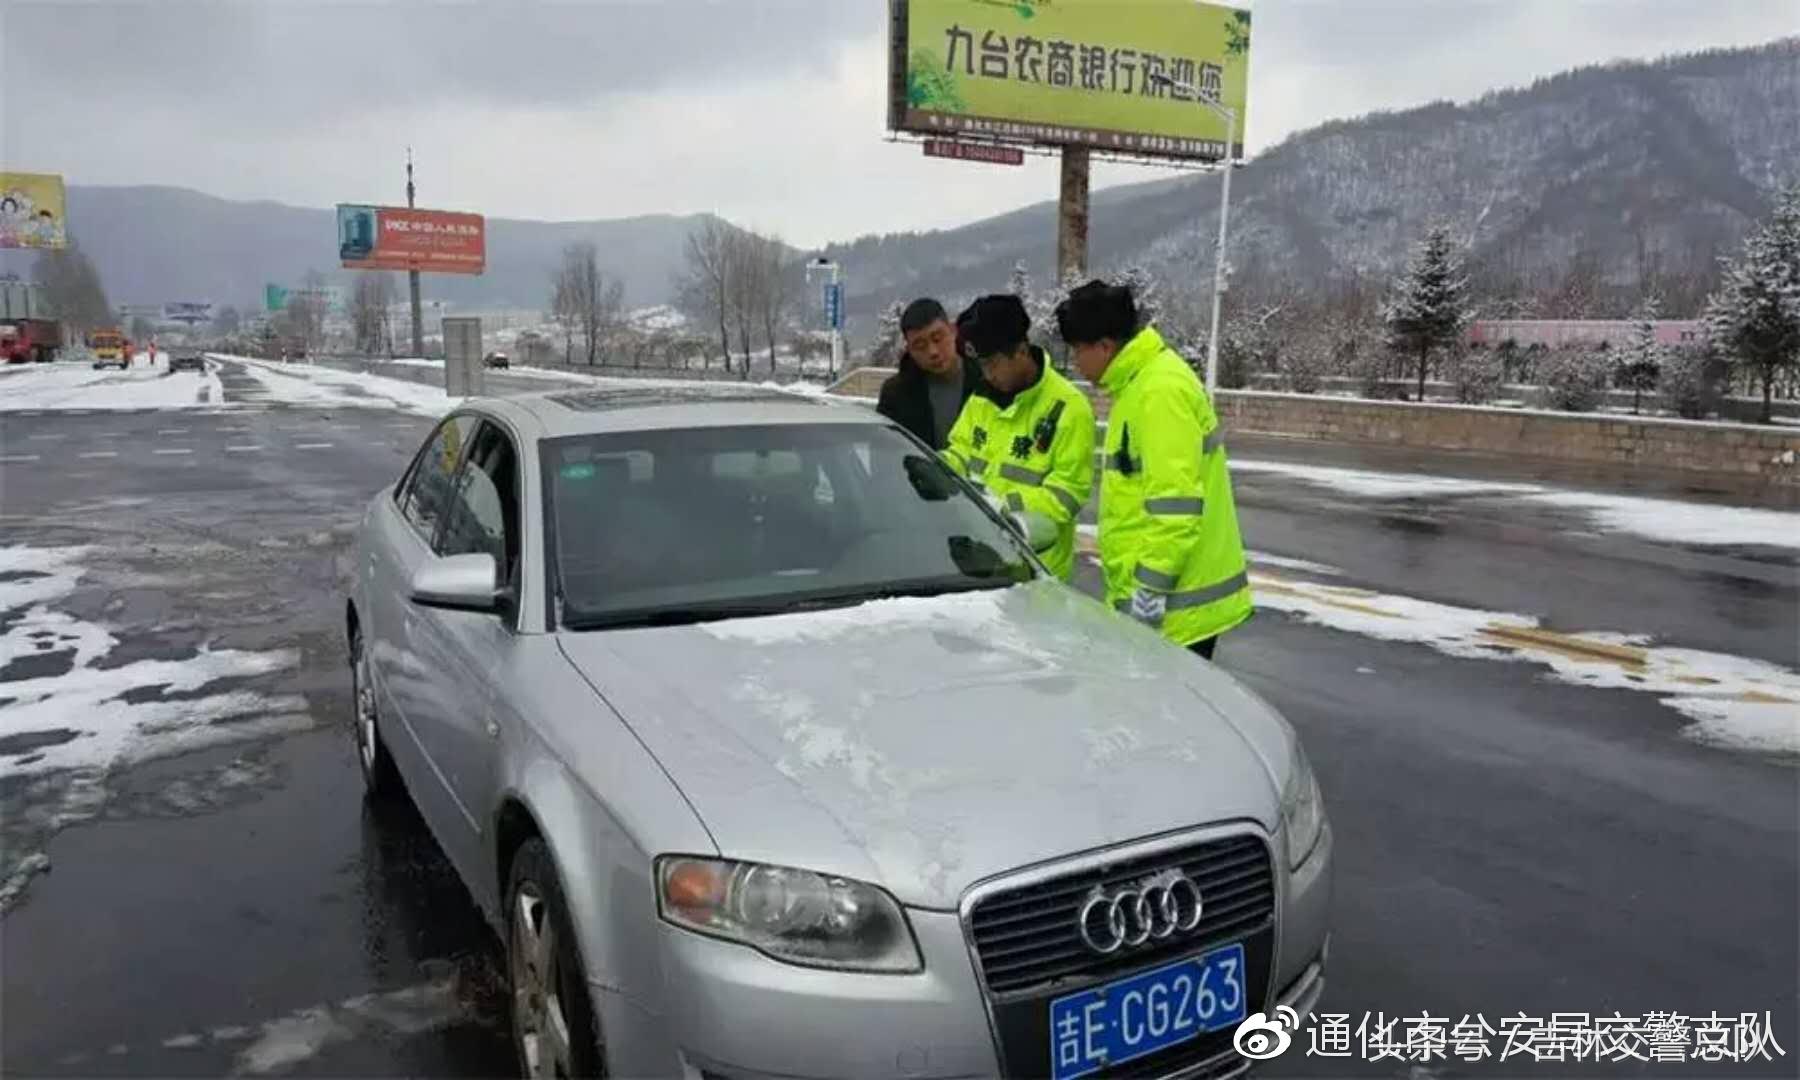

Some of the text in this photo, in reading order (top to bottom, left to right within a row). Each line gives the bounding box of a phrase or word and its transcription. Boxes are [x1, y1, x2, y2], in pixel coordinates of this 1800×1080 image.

[945, 23, 1224, 104] 九台农商银行欢迎您
